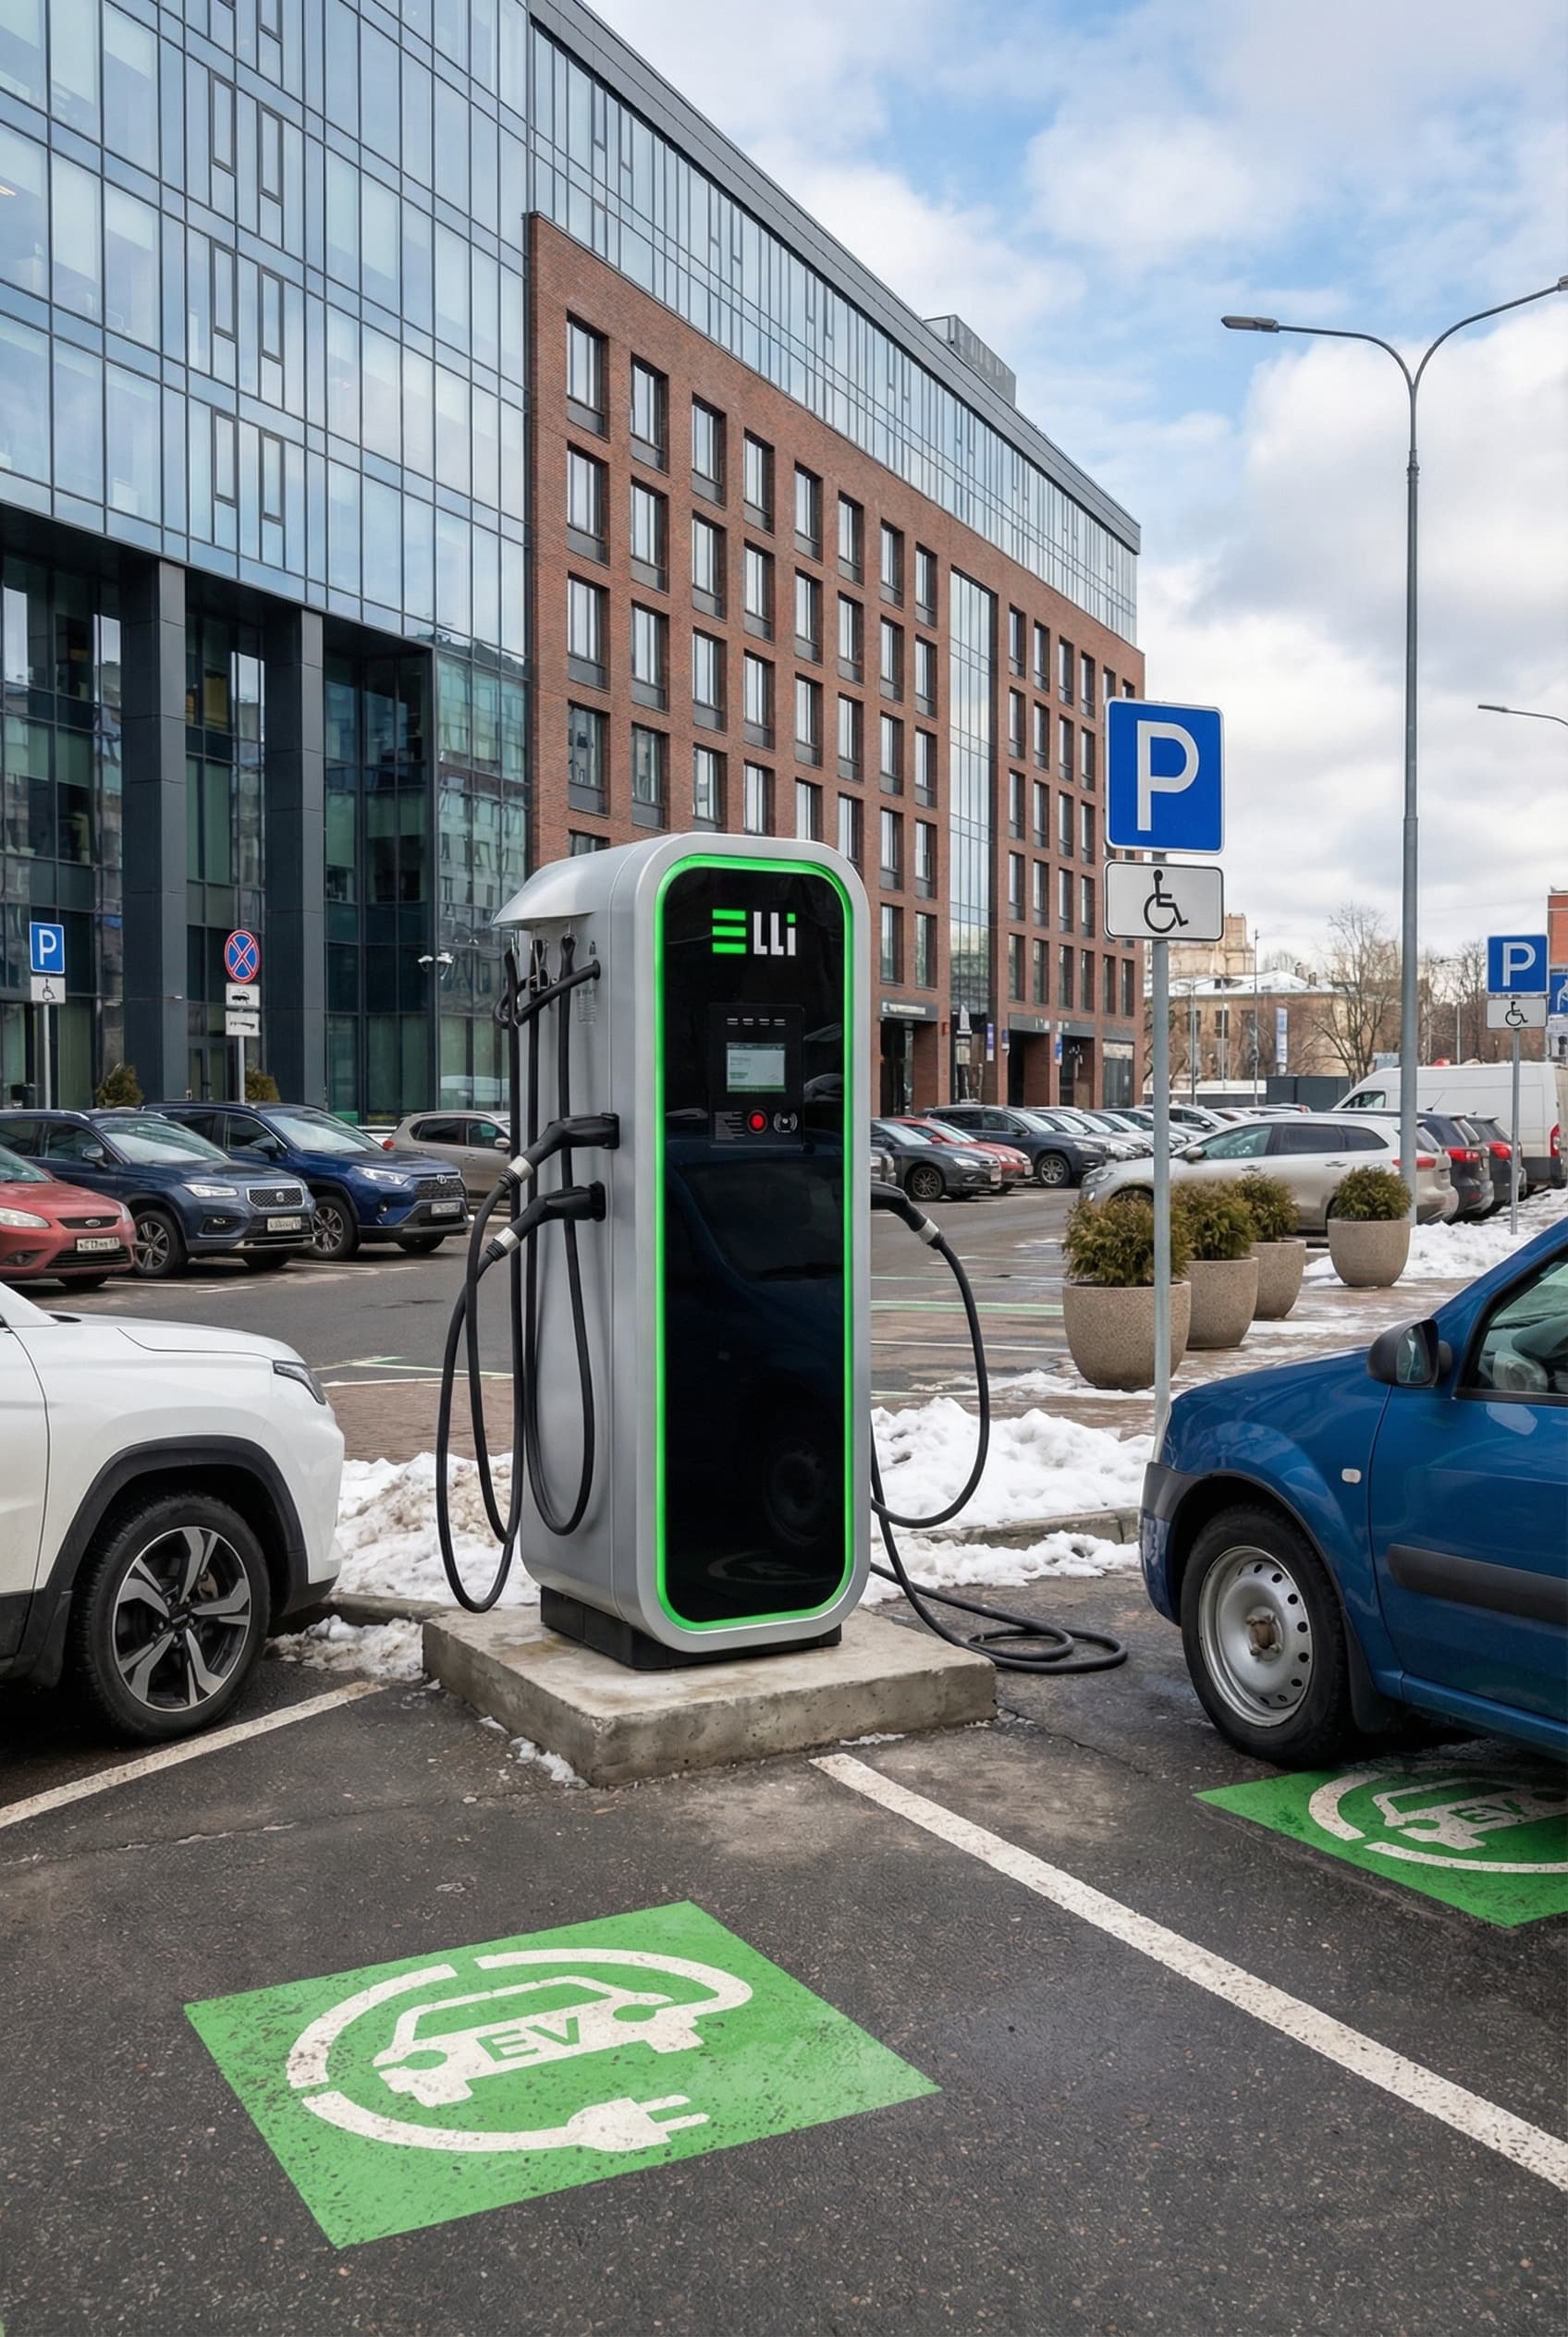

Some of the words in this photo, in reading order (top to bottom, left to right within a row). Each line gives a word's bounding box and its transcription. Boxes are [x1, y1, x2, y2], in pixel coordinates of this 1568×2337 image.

[1136, 720, 1200, 832] P
[39, 928, 57, 965] P
[1501, 941, 1537, 987] P
[475, 2016, 581, 2062] EV
